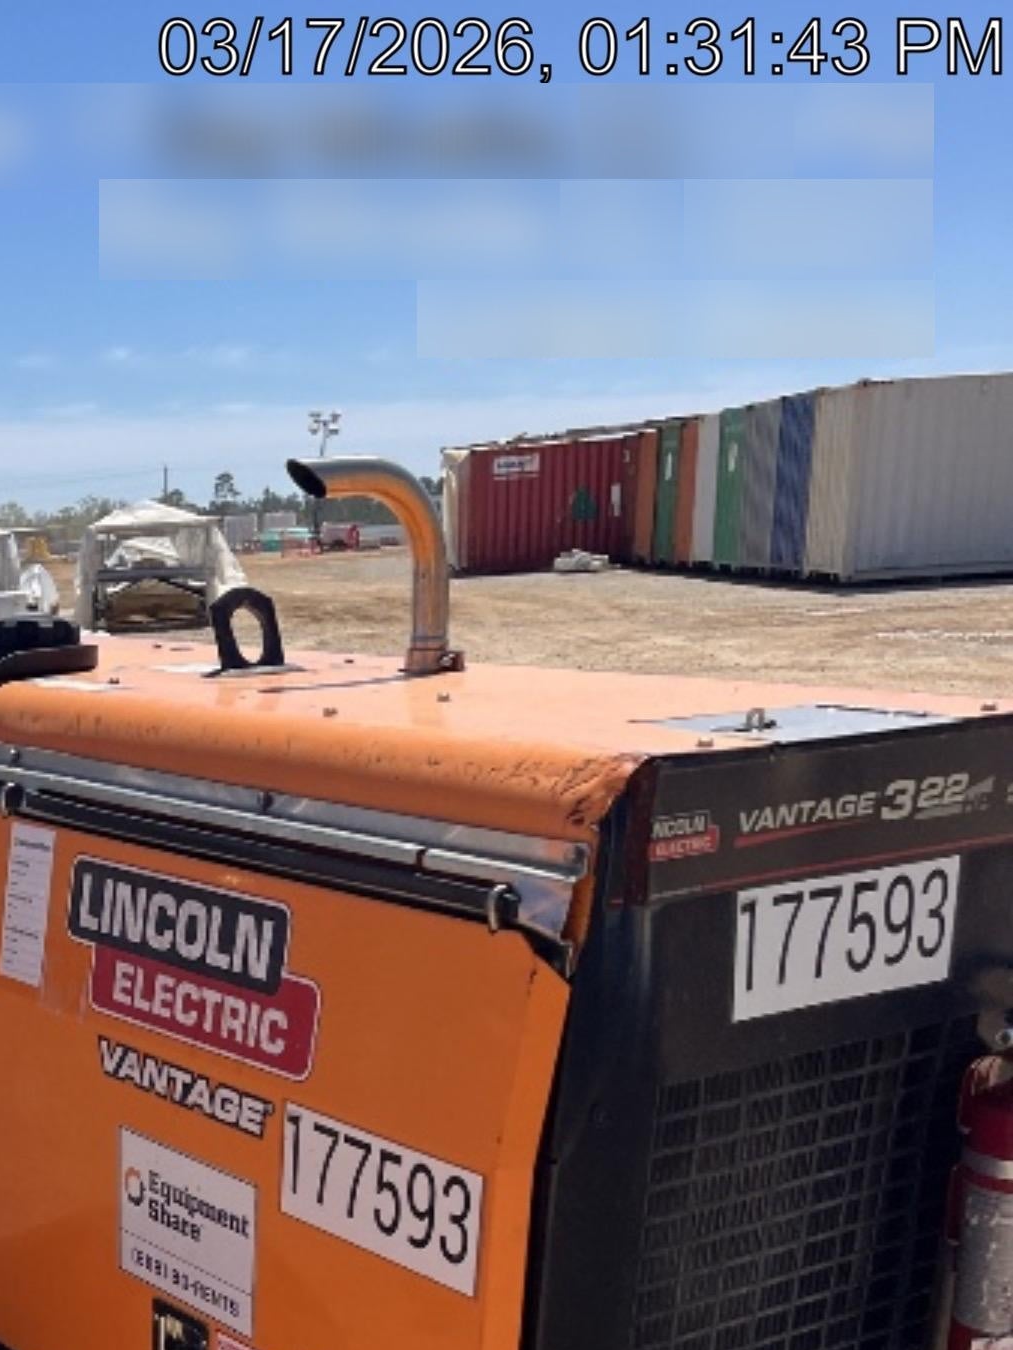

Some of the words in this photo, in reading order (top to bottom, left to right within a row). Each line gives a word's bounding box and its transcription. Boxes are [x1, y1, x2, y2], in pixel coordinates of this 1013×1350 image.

[739, 788, 877, 835] VANTAGE
[881, 772, 969, 821] 322
[78, 872, 275, 982] LINCOLN
[740, 868, 949, 991] 177593
[111, 959, 288, 1056] ELECTRIC
[99, 1037, 269, 1136] VANTAGE
[148, 1169, 250, 1240] Equipment
[148, 1198, 202, 1243] Share
[287, 1114, 471, 1265] 177593
